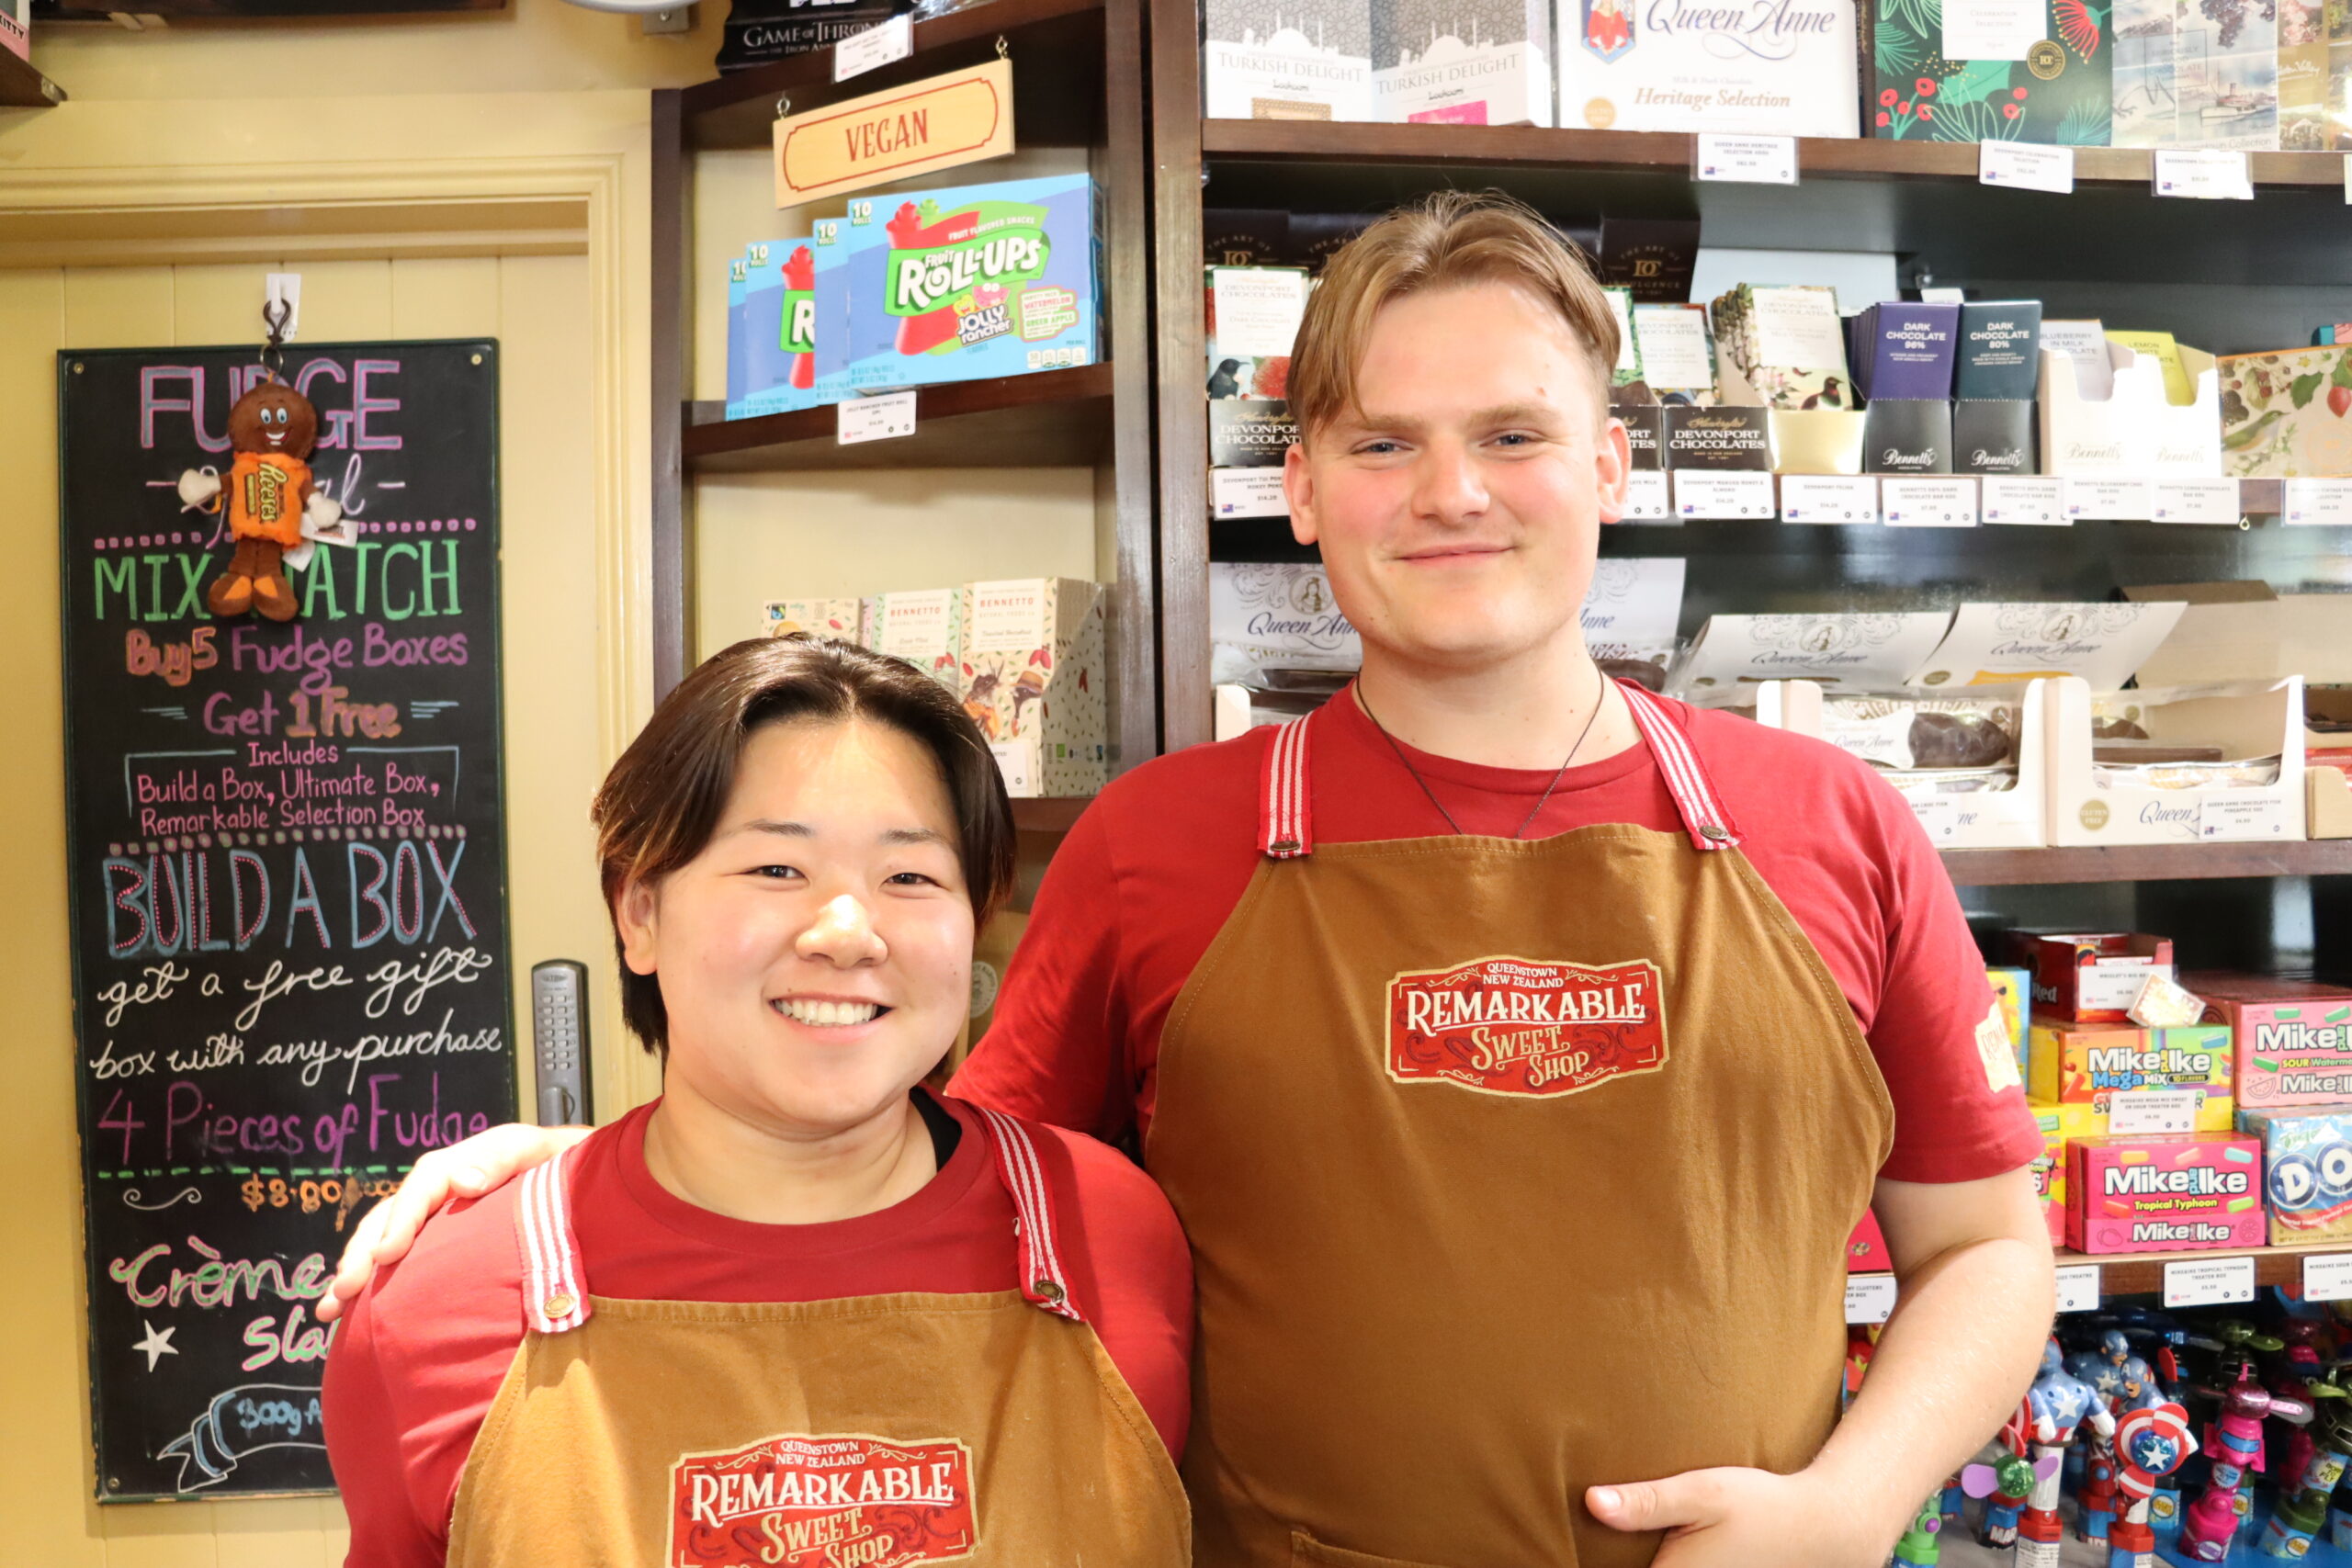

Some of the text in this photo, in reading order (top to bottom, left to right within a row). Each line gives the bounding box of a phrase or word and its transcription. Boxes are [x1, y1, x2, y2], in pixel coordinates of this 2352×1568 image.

[1645, 0, 1836, 37] Queen Anne
[743, 26, 800, 47] GAME
[1217, 51, 1364, 84] TURKISH DELIGHT
[1377, 53, 1520, 95] TURKISH DELIGHT
[1634, 87, 1791, 111] Heritage Selection
[845, 108, 929, 162] VEGAN
[853, 201, 872, 218] 10
[819, 222, 838, 239] 10
[750, 245, 769, 260] 10
[958, 304, 1006, 334] JOLLY
[961, 319, 1011, 344] rancher
[1904, 322, 1931, 332] DARK
[1987, 322, 2014, 332] DARK
[1885, 331, 1946, 341] CHOCOLATE
[1970, 331, 2030, 341] CHOCOLATE
[140, 357, 402, 452] FUGE
[1669, 439, 1766, 449] CHOCOLATES
[1674, 429, 1761, 439] DEVONPORT
[94, 538, 462, 622] MIX ATCH
[889, 605, 943, 617] BENNETTO
[979, 597, 1035, 608] BENNETTO
[1248, 611, 1358, 637] Queen Ann
[232, 625, 353, 695] Fudge
[363, 622, 469, 668] Boxes
[203, 686, 402, 738] Get 1 Free
[248, 739, 338, 767] Includes
[137, 773, 198, 804] Build
[203, 784, 216, 802] a
[281, 770, 377, 799] Ultimate
[141, 798, 425, 836] Remarkable Selection Box
[2139, 800, 2193, 825] Queen
[103, 840, 478, 959] BUILD A BOX
[1482, 974, 1565, 988] NEW ZEALAND
[1487, 962, 1557, 977] QUEENSTOWN
[97, 946, 492, 1031] get a free gift
[1407, 983, 1646, 1037] REMARKABLE
[1471, 1024, 1564, 1071] SWEET
[2256, 1021, 2337, 1052] Mike
[91, 1009, 502, 1095] box with any purchase
[2088, 1047, 2161, 1073] Mike
[2169, 1048, 2212, 1073] Ike
[2282, 1058, 2311, 1069] SOUR
[1529, 1051, 1590, 1088] SHOP
[2092, 1070, 2144, 1090] Mega
[2281, 1074, 2337, 1094] Mike
[97, 1088, 146, 1166] 4
[166, 1080, 304, 1161] Pieces
[313, 1102, 359, 1171] of
[2104, 1165, 2190, 1196] Mike
[2197, 1166, 2249, 1196] Ike
[2133, 1197, 2218, 1212] Tropical Typhoon
[2132, 1222, 2190, 1243] Mike
[2197, 1223, 2232, 1242] Ike
[109, 1235, 338, 1308] Crème
[775, 1452, 865, 1468] NEW ZEALAND
[780, 1440, 860, 1454] QUEENSTOWN
[691, 1462, 956, 1529] REMARKABLE
[761, 1506, 864, 1564] SWEET
[823, 1534, 895, 1568] SHOP
